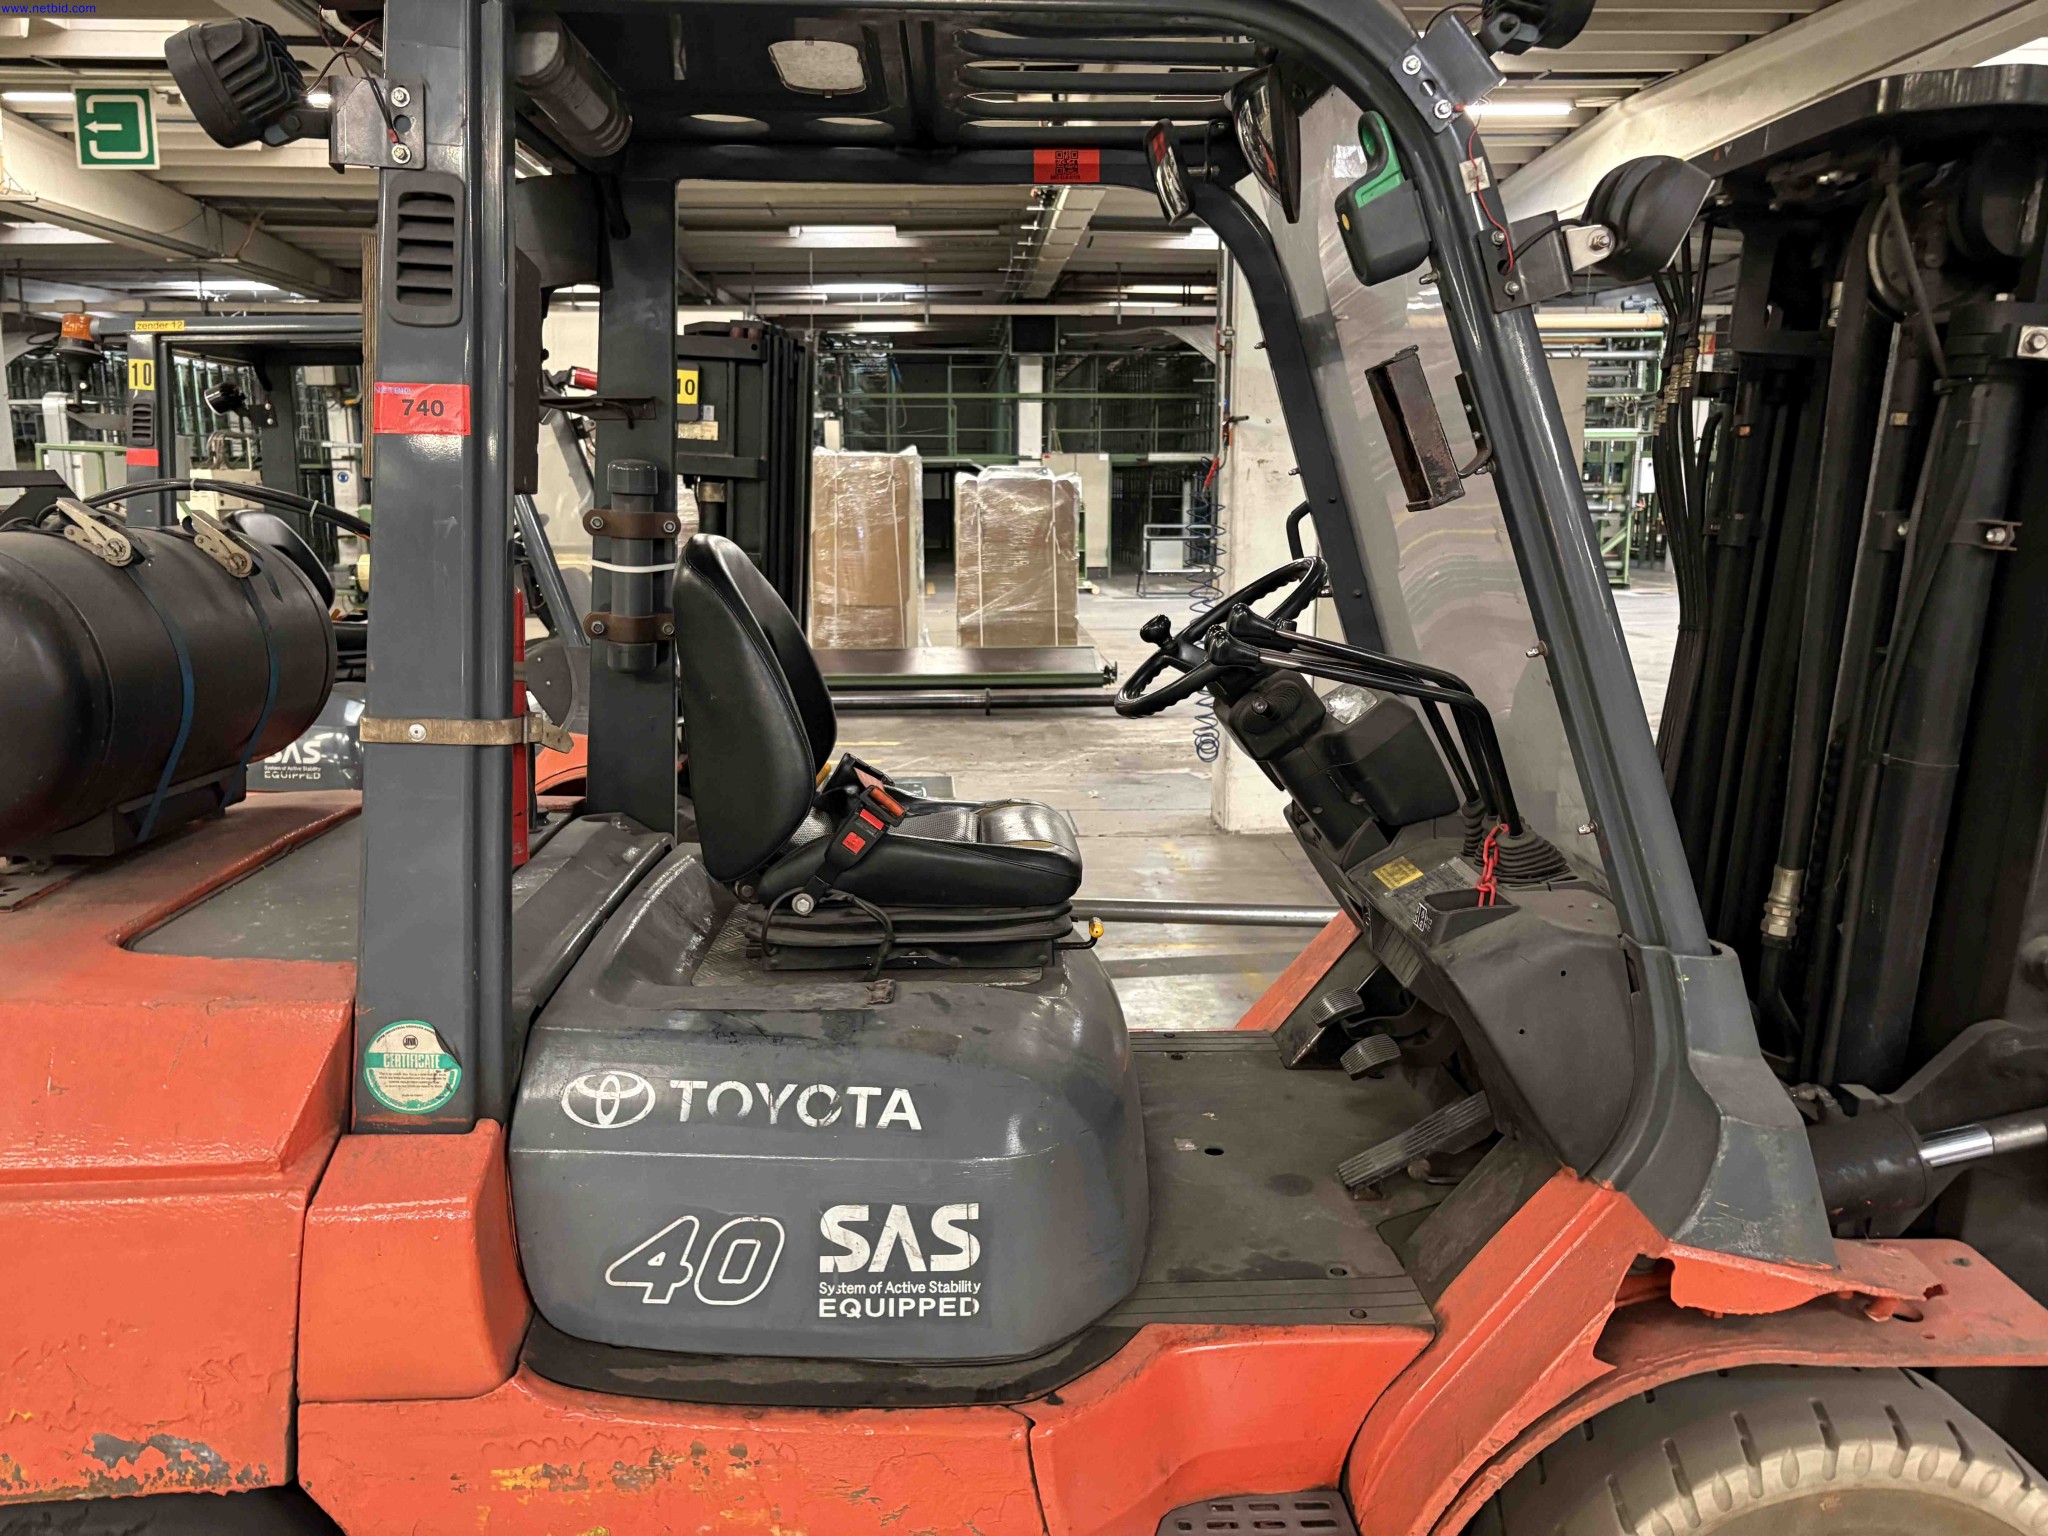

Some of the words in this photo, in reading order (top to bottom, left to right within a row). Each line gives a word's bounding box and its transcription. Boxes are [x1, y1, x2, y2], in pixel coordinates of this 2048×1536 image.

[136, 321, 169, 330] zender
[172, 320, 183, 330] 12
[132, 362, 151, 386] 10
[402, 399, 444, 416] 740
[383, 1053, 440, 1069] CERTIFICATE
[670, 1080, 922, 1131] TOYOTA
[819, 1203, 980, 1272] SAS
[604, 1214, 786, 1307] 40
[819, 1282, 866, 1296] System
[869, 1281, 883, 1294] of
[885, 1281, 926, 1294] Active
[928, 1280, 981, 1294] Stability
[818, 1296, 980, 1319] EQUIPPED
